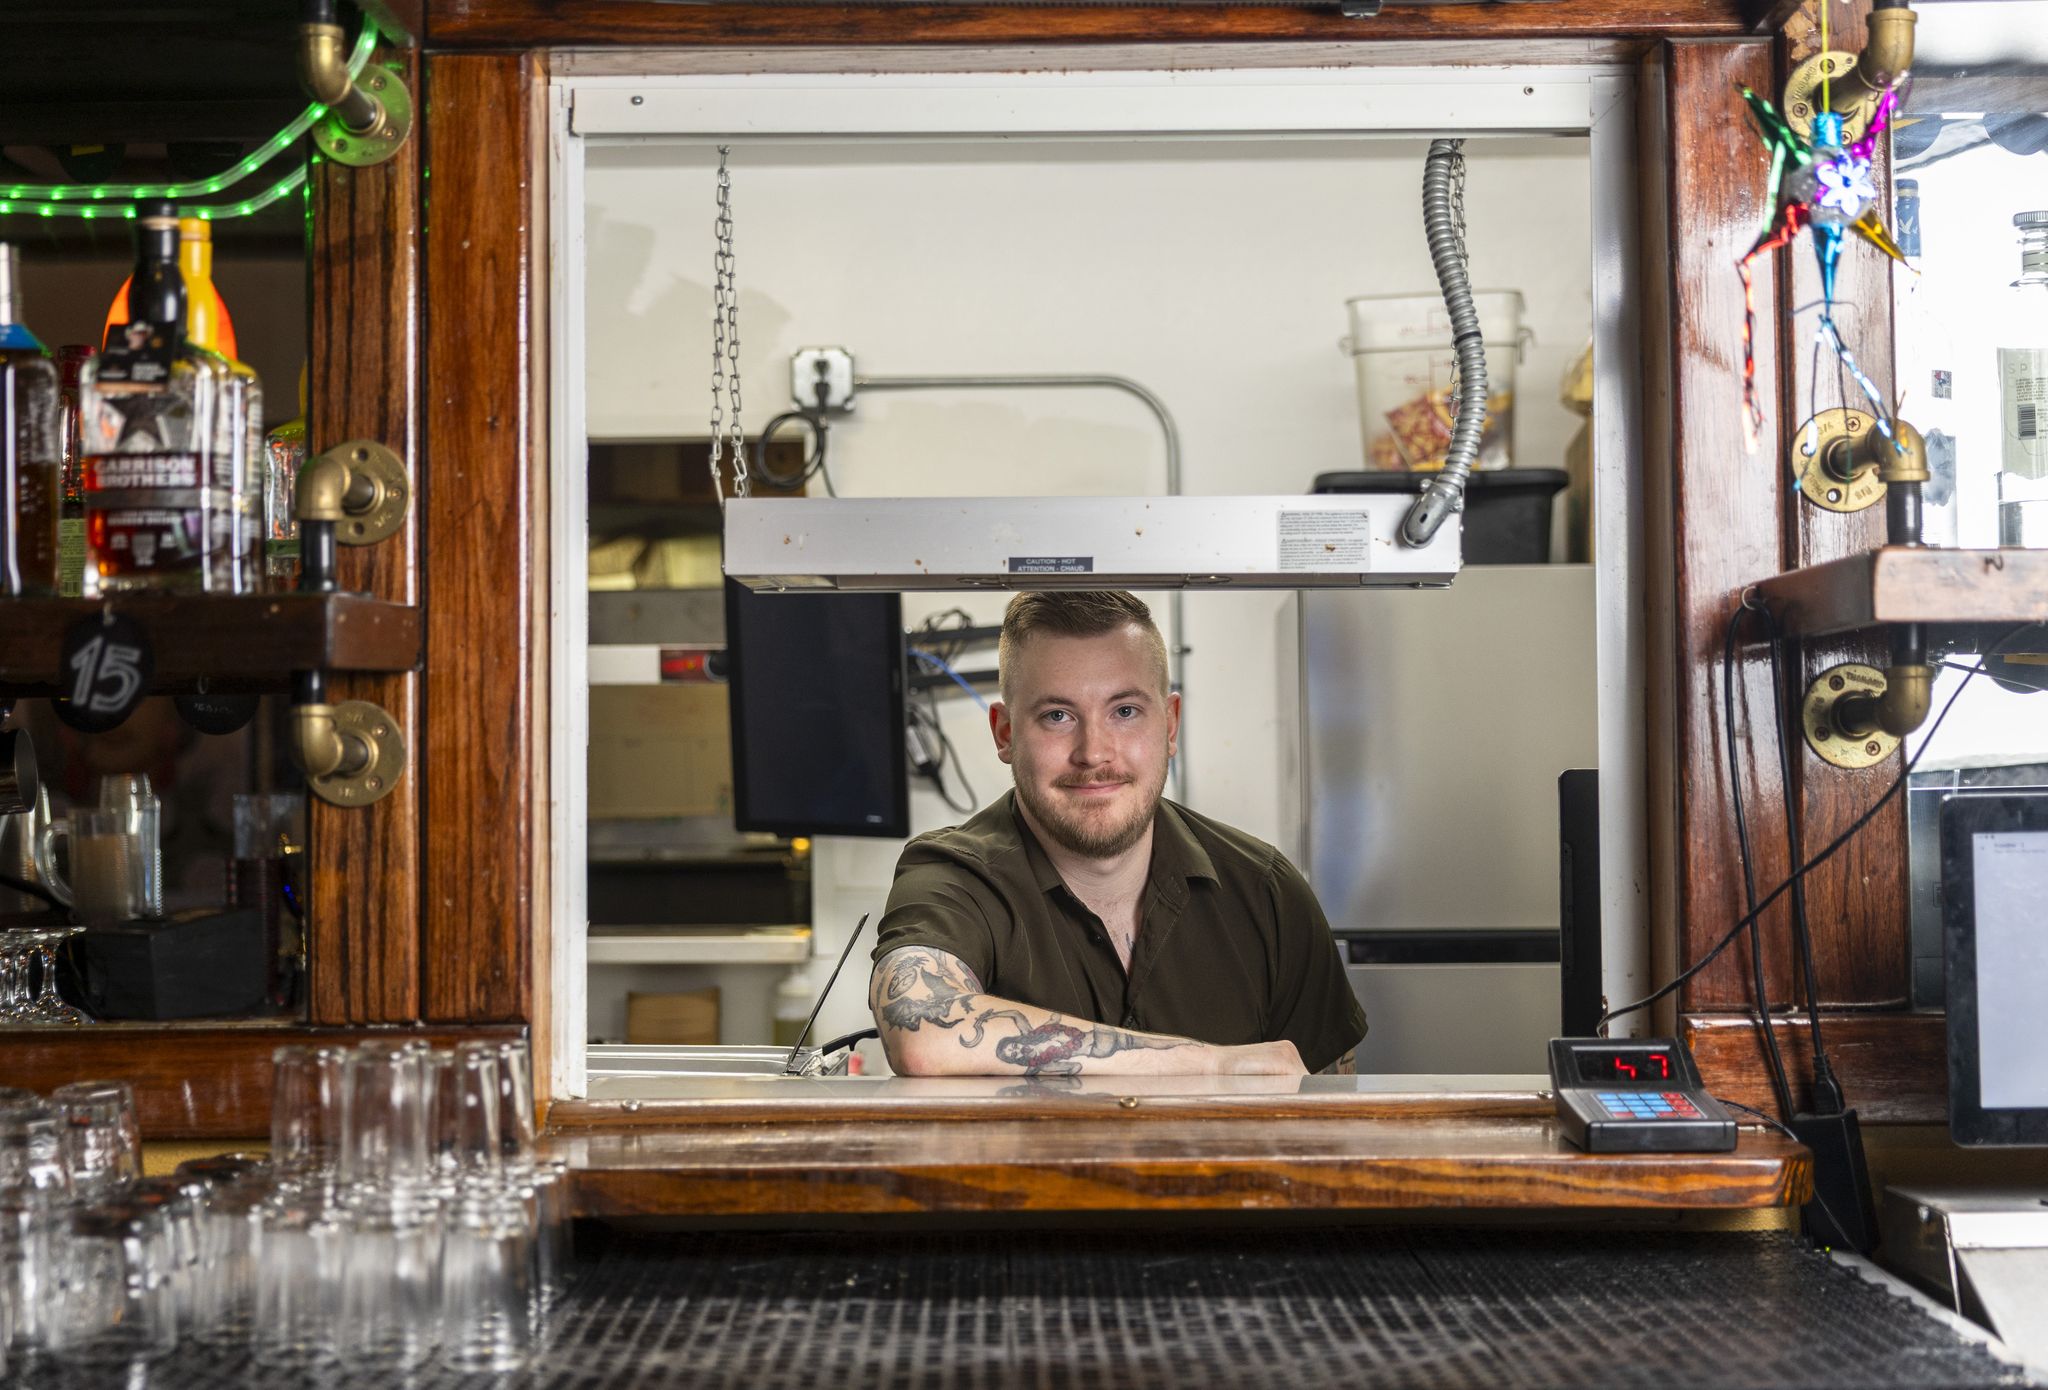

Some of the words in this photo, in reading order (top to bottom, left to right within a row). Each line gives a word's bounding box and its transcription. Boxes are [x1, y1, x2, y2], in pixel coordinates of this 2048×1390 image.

[95, 456, 196, 473] GARRISON
[96, 473, 196, 488] BROTHERS
[70, 635, 143, 714] 15
[1614, 1054, 1669, 1080] 47
